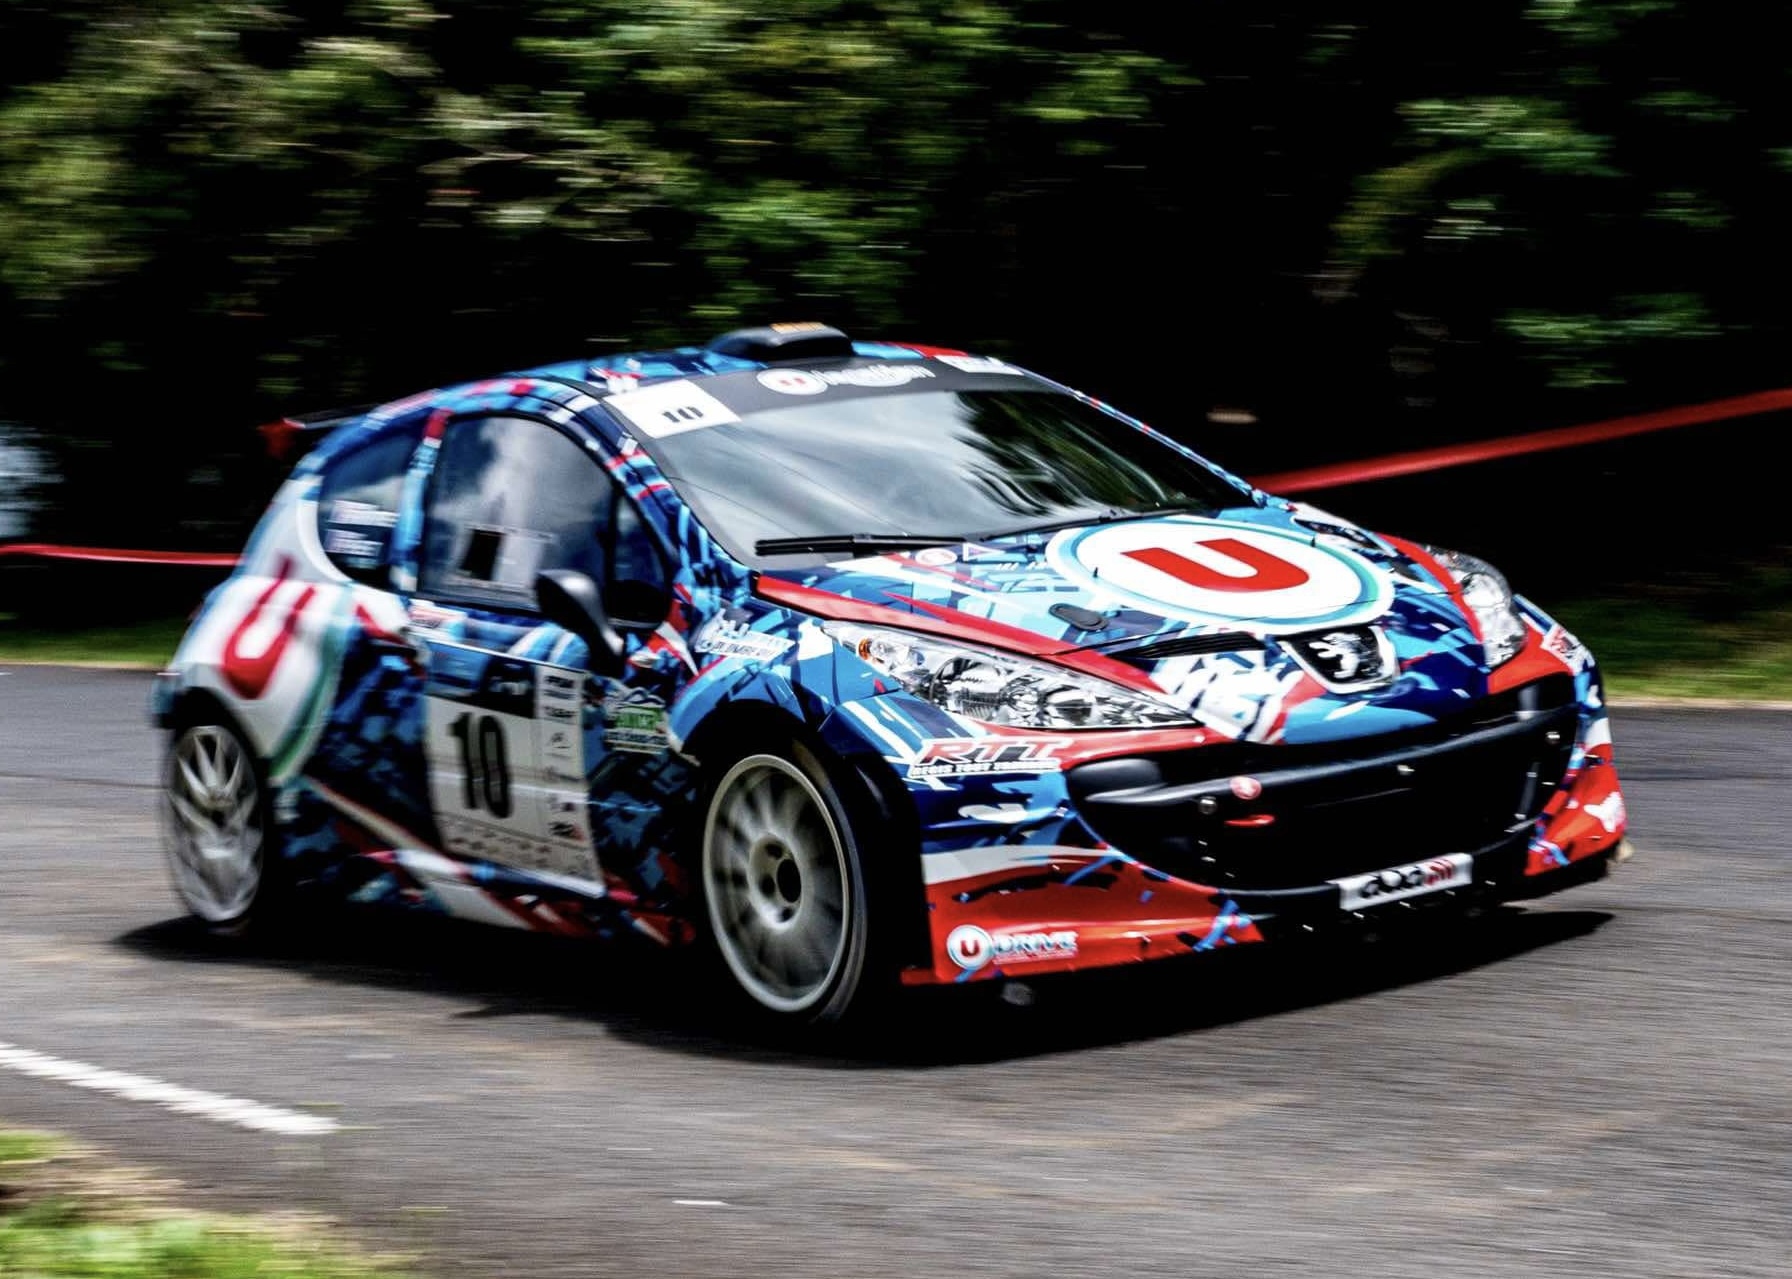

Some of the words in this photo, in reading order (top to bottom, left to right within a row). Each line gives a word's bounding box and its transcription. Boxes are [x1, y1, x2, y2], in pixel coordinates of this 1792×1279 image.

[662, 406, 704, 423] 10
[1120, 538, 1310, 593] U
[222, 551, 315, 700] U
[448, 712, 513, 819] 10
[960, 939, 981, 958] U
